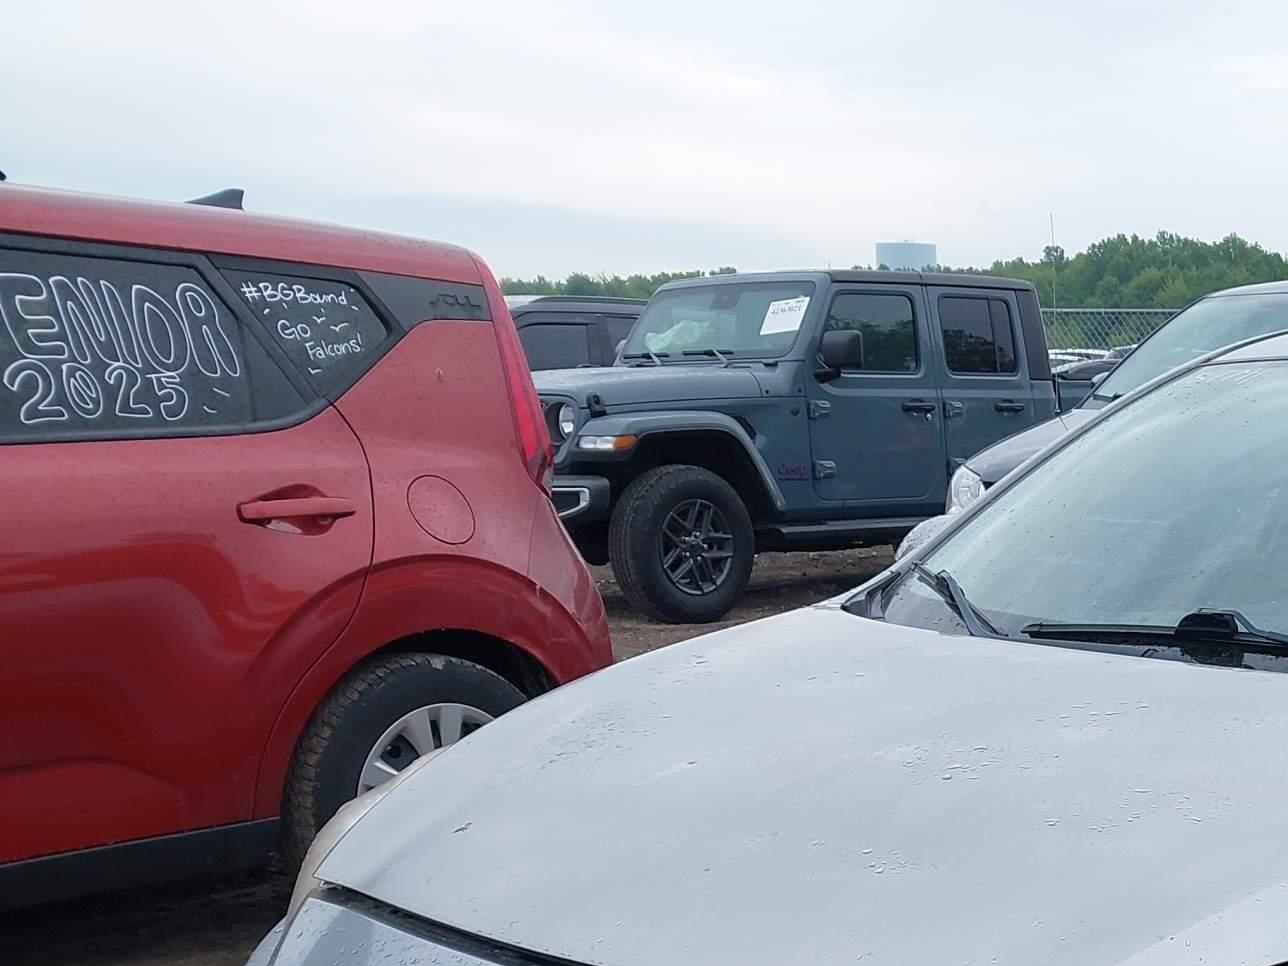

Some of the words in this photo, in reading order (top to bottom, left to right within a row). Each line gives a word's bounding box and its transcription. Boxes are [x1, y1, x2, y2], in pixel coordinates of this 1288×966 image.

[240, 281, 348, 306] #BGBound
[277, 319, 311, 340] Go
[304, 332, 366, 361] Falcons!
[3, 358, 189, 424] 2025
